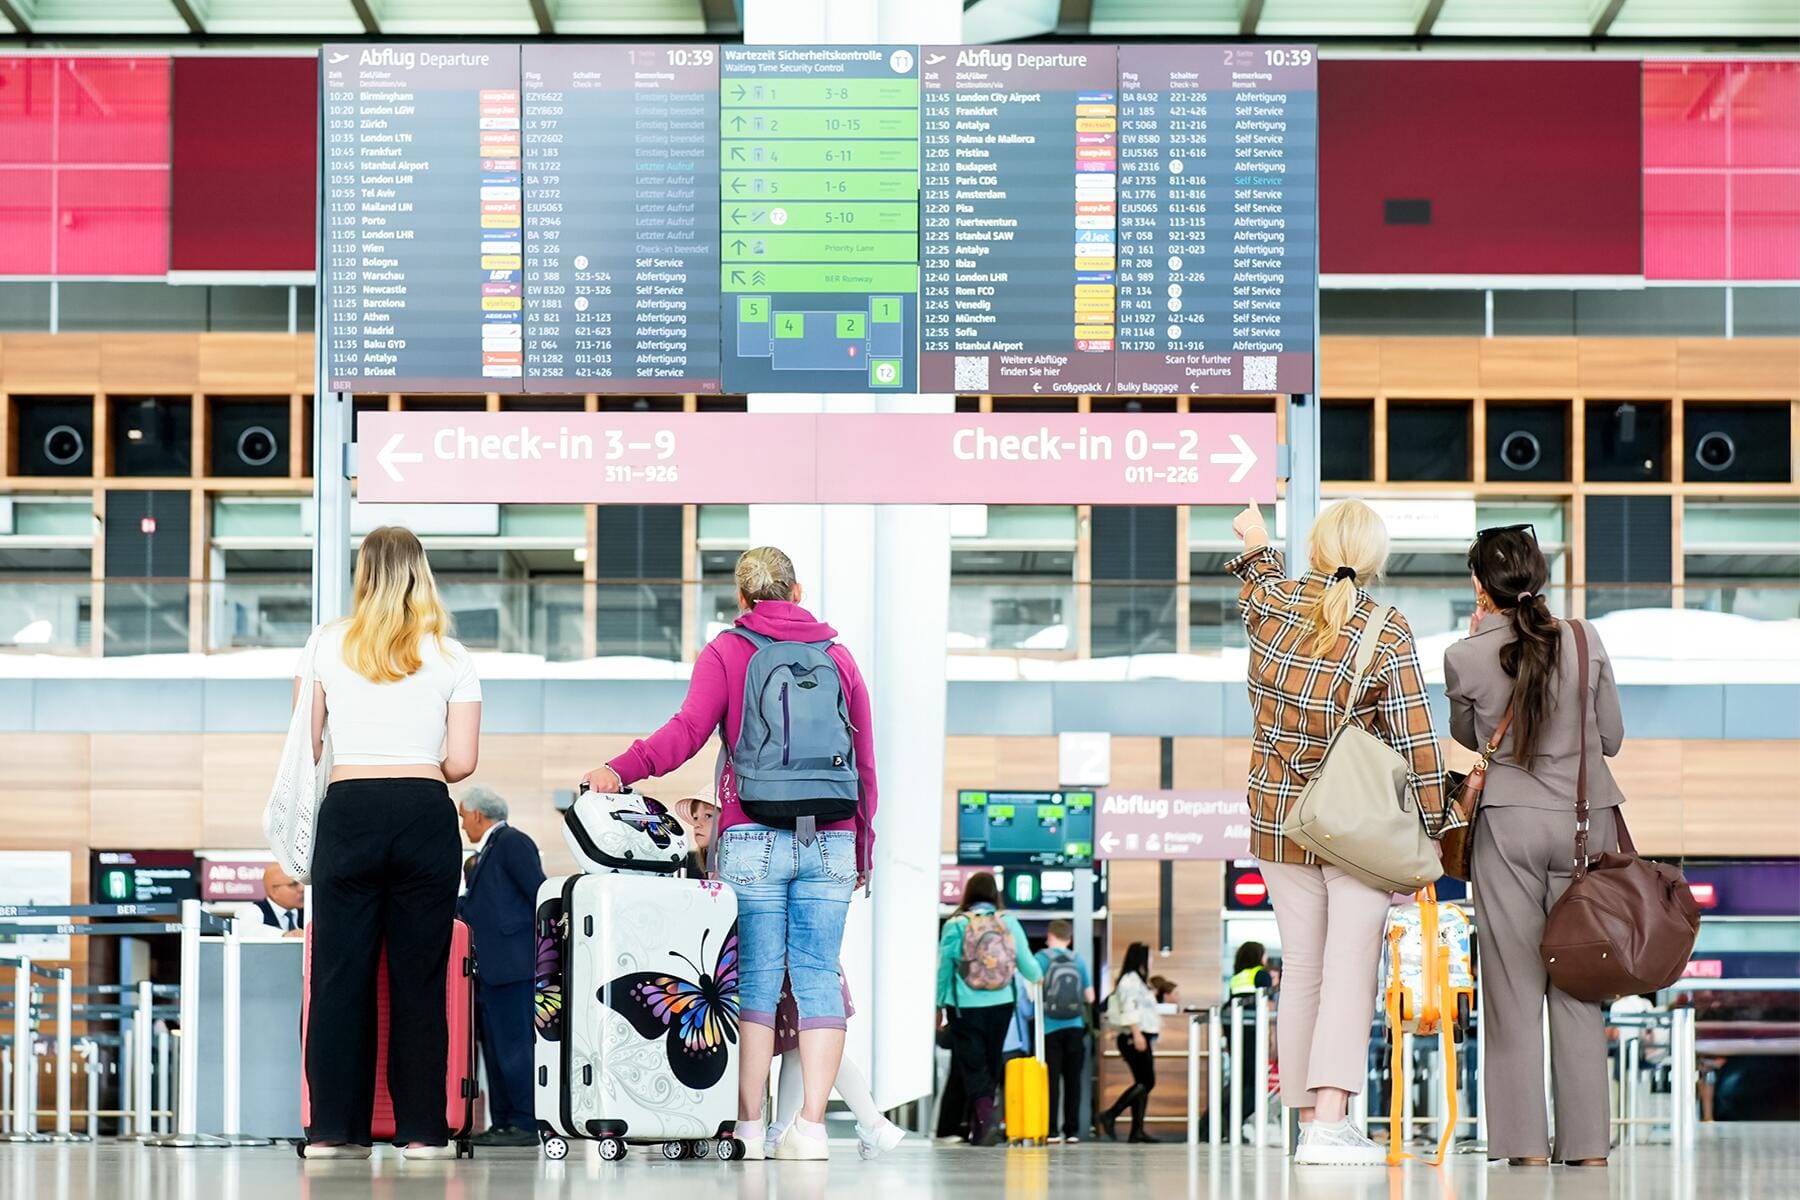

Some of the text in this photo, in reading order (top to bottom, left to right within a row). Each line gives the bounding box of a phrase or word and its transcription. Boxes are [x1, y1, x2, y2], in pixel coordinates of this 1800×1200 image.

[359, 48, 489, 69] Abflug Departure
[666, 49, 713, 65] 10:39
[725, 50, 882, 60] Wartezeit Sicherheitskontrolle
[956, 48, 1086, 70] Abflug Departure
[1223, 50, 1233, 65] 2
[1264, 49, 1311, 65] 10:39
[896, 57, 908, 67] T1
[724, 63, 844, 73] Waiting Time Security Control
[1122, 72, 1137, 82] Flug
[1232, 72, 1272, 83] Bemerkung
[360, 91, 413, 102] Birmingham
[771, 89, 848, 100] 1 3-8
[956, 92, 1040, 103] London City Airport
[1170, 92, 1207, 101] 221-226
[360, 105, 414, 114] London LGW
[956, 106, 997, 115] Frankfurt
[1170, 106, 1206, 115] 421-426
[360, 119, 387, 128] Zürich
[771, 120, 860, 131] 2 10-15
[955, 120, 989, 131] Antalya
[1169, 120, 1206, 129] 211-216
[360, 133, 412, 142] London LTN
[956, 134, 1035, 143] Palma de Mallorca
[1170, 134, 1206, 143] 323-326
[360, 147, 401, 156] Frankfurt
[956, 148, 989, 157] Pristina
[1169, 148, 1206, 157] 611-616
[771, 151, 852, 162] 4 6-11
[360, 161, 428, 171] Istanbul Airport
[956, 162, 997, 173] Budapest
[361, 174, 412, 183] London LHR
[955, 175, 997, 185] Paris CDG
[1169, 176, 1206, 185] 811-816
[771, 182, 847, 193] 5 1-6
[361, 188, 395, 197] Tel Aviv
[955, 189, 1006, 198] Amsterdam
[1169, 189, 1205, 198] 811-816
[361, 202, 412, 211] Mailand LIN
[956, 203, 973, 212] Pisa
[1169, 203, 1206, 212] 611-616
[361, 216, 385, 225] Porto
[773, 212, 854, 224] T2 5-10
[955, 217, 1017, 226] Fuerteventura
[1169, 217, 1205, 226] 113-115
[362, 229, 413, 239] London LHR
[955, 231, 1013, 240] Istanbul SAW
[1168, 231, 1205, 240] 921-923
[362, 243, 384, 252] Wien
[825, 244, 854, 253] Priority
[955, 244, 989, 256] Antalya
[1168, 245, 1205, 254] 021-023
[362, 257, 398, 268] Bologna
[955, 258, 976, 267] Ibiza
[362, 271, 404, 280] Warschau
[574, 272, 610, 280] 523-524
[825, 275, 873, 284] BER Runway
[955, 272, 1007, 281] London LHR
[1168, 272, 1205, 281] 221-226
[363, 284, 406, 293] Newcastle
[575, 285, 611, 294] 323-326
[955, 286, 994, 295] Rom FCO
[363, 298, 405, 307] Barcelona
[955, 299, 990, 311] Venedig
[750, 304, 758, 316] 5
[882, 304, 889, 316] 1
[363, 312, 389, 321] Athen
[576, 313, 611, 322] 121-123
[955, 313, 995, 322] München
[1168, 313, 1204, 322] 421-426
[363, 325, 393, 334] Madrid
[785, 320, 793, 331] 4
[847, 320, 854, 331] 2
[575, 326, 611, 335] 621-623
[955, 327, 977, 336] Sofia
[363, 339, 405, 348] Baku GYD
[575, 340, 611, 349] 713-716
[955, 341, 1023, 352] Istanbul Airport
[1167, 341, 1204, 350] 911-916
[363, 353, 397, 364] Antalya
[575, 354, 611, 362] 011-013
[1000, 354, 1067, 366] Weitere Abflüge
[1165, 354, 1231, 364] Scan for further
[364, 367, 395, 375] Brüssel
[575, 367, 612, 376] 421-426
[880, 368, 892, 377] T2
[1000, 366, 1060, 376] finden Sie hier
[1185, 367, 1231, 377] Departures
[333, 381, 351, 389] BER
[1052, 382, 1178, 394] Großgepäck / Bulky Baggage
[434, 427, 592, 460] Check-in
[953, 427, 1112, 461] Check-in
[1102, 794, 1168, 819] Abflug
[117, 905, 136, 915] BER
[57, 924, 74, 934] BER
